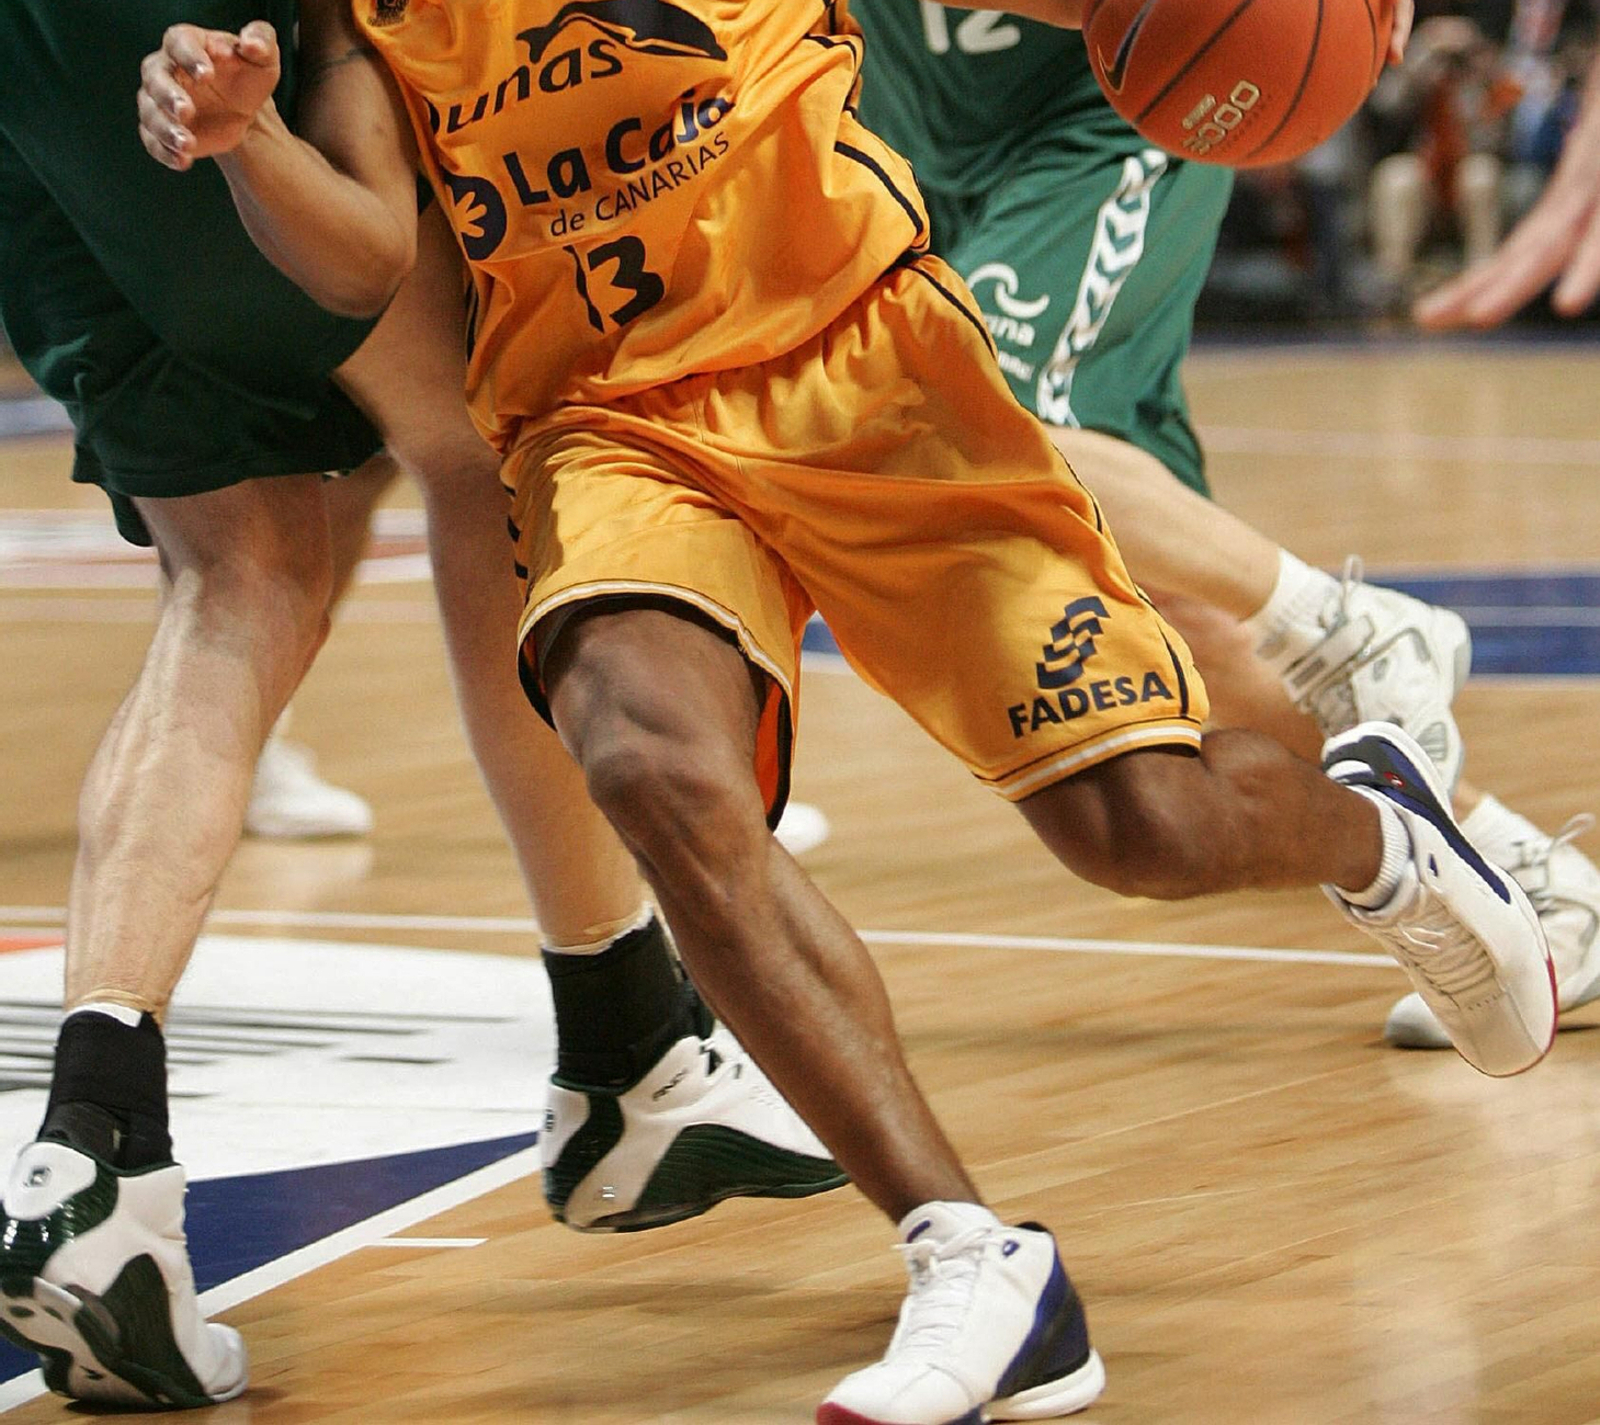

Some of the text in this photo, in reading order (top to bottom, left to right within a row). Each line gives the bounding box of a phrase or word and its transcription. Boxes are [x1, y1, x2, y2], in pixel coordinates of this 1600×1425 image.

[423, 39, 623, 135] unas
[502, 147, 593, 206] La
[550, 131, 729, 237] de CANARIAS
[563, 234, 666, 335] 13
[1008, 671, 1175, 739] FADESA
